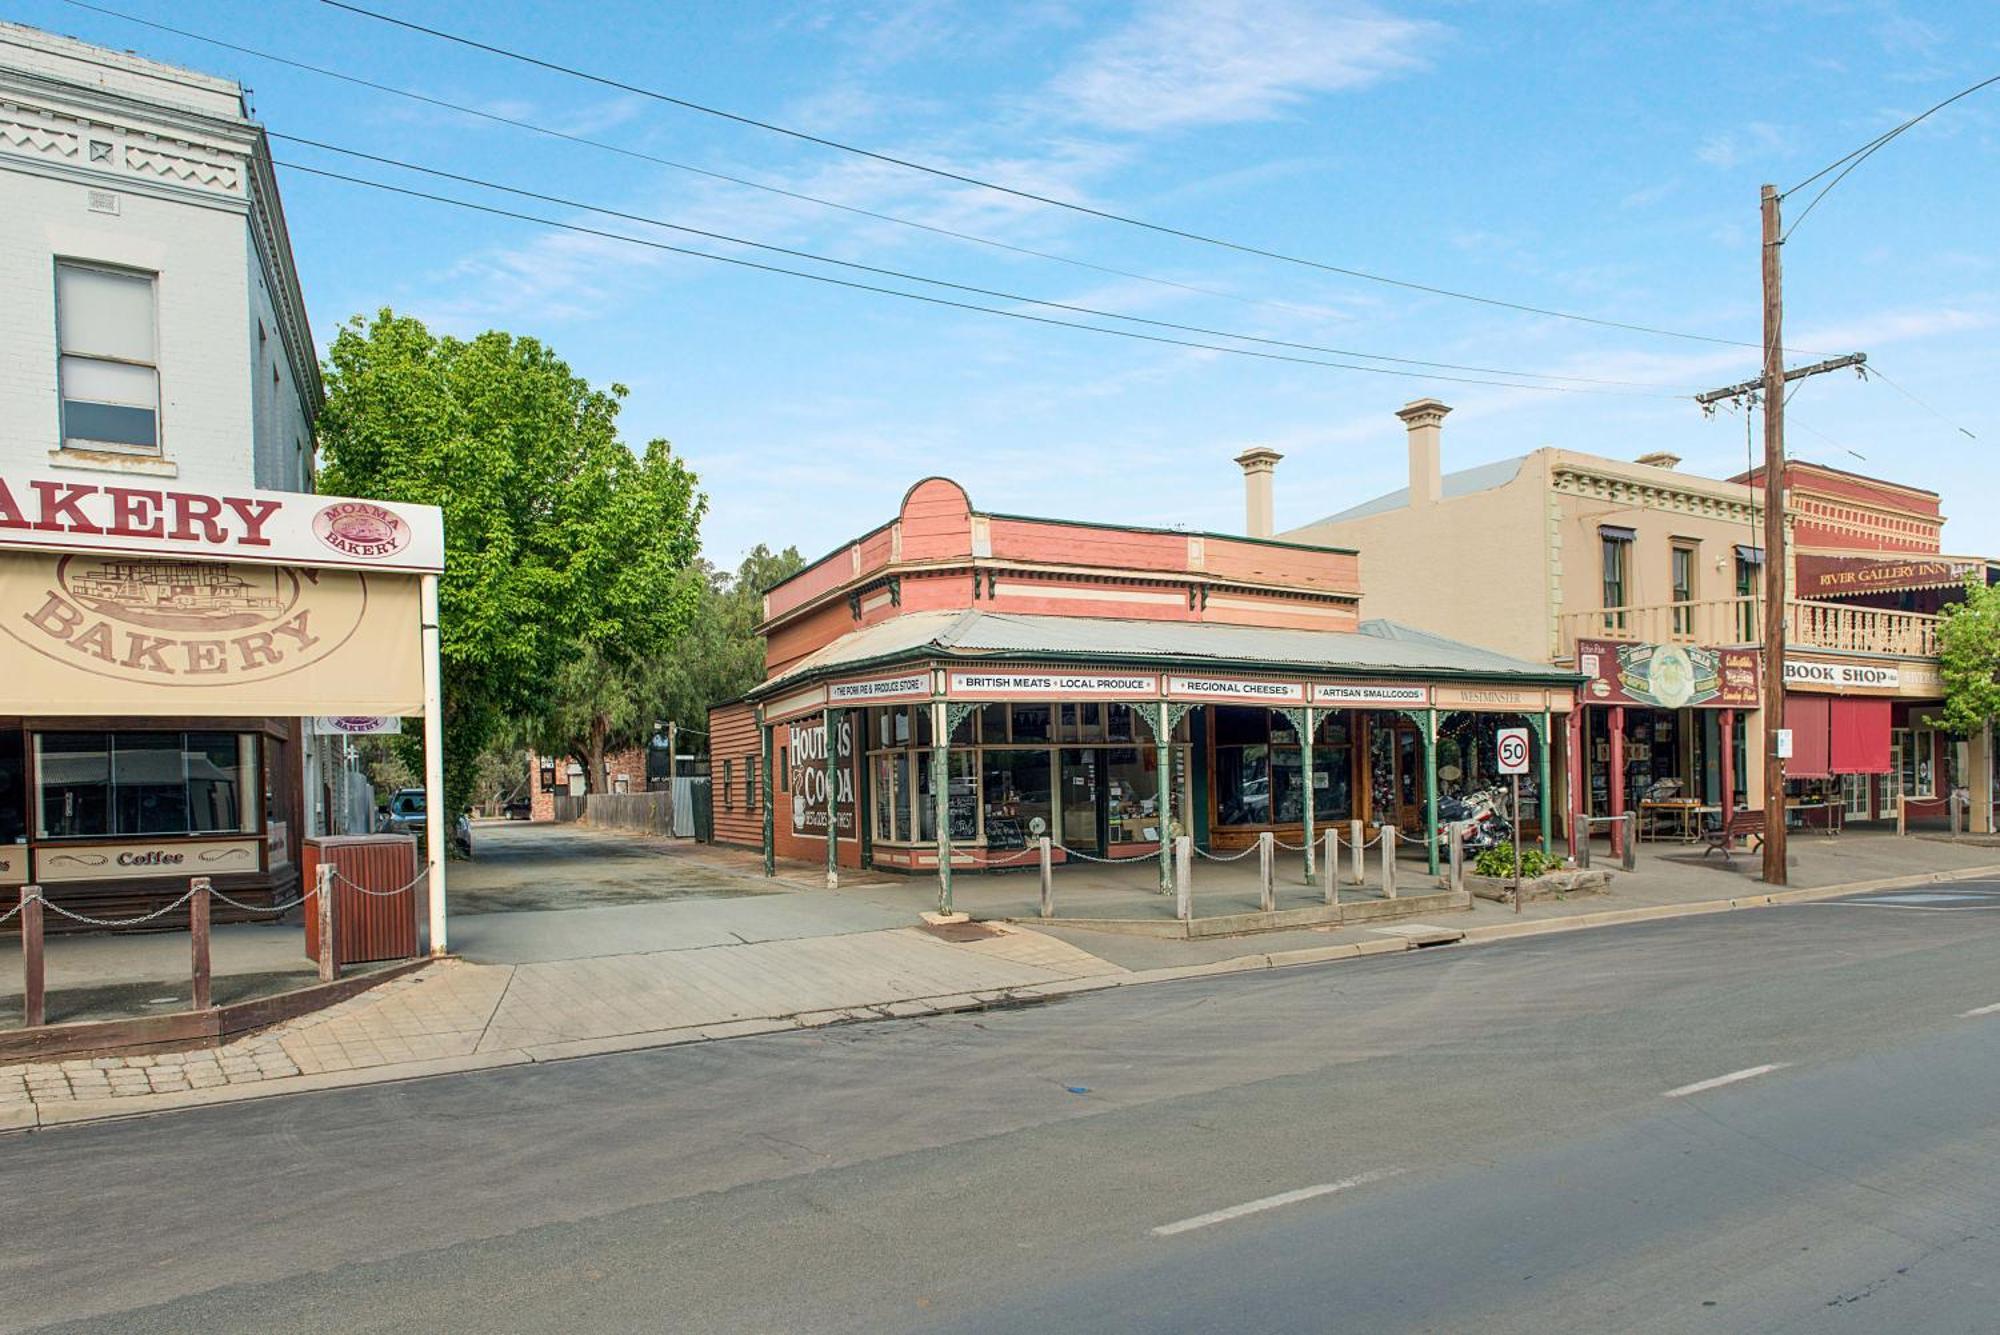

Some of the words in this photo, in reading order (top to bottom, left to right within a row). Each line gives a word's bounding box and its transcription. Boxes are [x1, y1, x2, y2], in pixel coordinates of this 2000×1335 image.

[324, 504, 400, 530] MOAMA
[325, 532, 398, 555] BAKERY
[1820, 572, 1855, 586] RIVER
[1858, 565, 1915, 581] GALLERY
[1919, 563, 1946, 575] INN
[23, 590, 321, 674] BAKERY
[1785, 664, 1834, 680] BOOK
[1842, 668, 1887, 682] SHOP
[874, 681, 898, 694] PRODUCE
[900, 679, 920, 691] STORE
[966, 678, 1010, 688] BRITISH
[1013, 678, 1051, 688] MEATS
[1060, 680, 1095, 689] LOCAL
[1097, 680, 1144, 689] PRODUCE
[1187, 682, 1240, 692] REGIONAL
[1243, 684, 1288, 695] CHEESES
[1323, 688, 1361, 698] ARTISAN
[1363, 690, 1419, 699] SMALLGOODS
[1460, 690, 1521, 703] WESTMINSTER
[334, 719, 380, 732] BAKERY
[790, 717, 852, 766] HOUT'S
[1502, 743, 1524, 760] 50
[117, 850, 184, 866] Coffee
